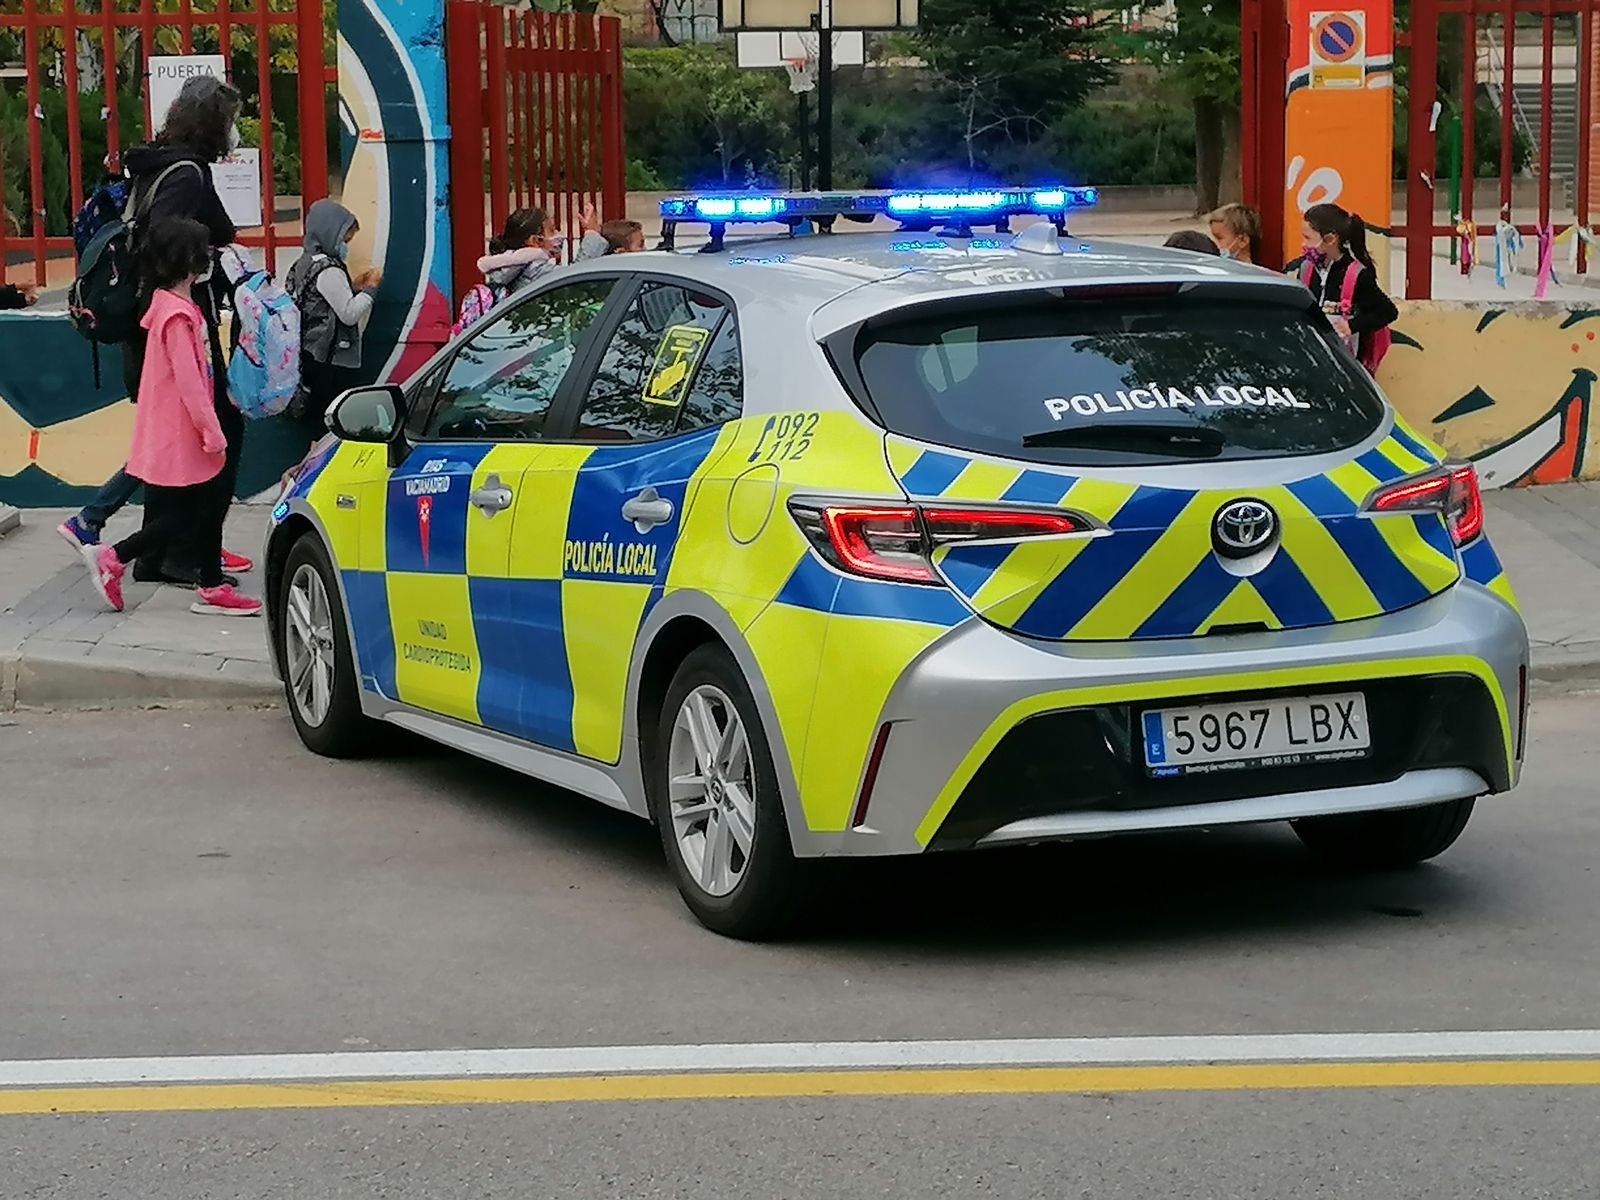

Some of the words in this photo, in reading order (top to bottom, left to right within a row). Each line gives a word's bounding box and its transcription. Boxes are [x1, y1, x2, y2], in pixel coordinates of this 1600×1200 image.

[157, 65, 214, 78] PUERTA
[1044, 382, 1195, 421] POLICÍA
[1194, 385, 1310, 409] LOCAL
[777, 412, 819, 439] 092
[766, 439, 810, 461] 112
[564, 531, 614, 574] POLICÍA
[616, 542, 657, 576] LOCAL
[1173, 708, 1270, 755] 5967
[1285, 700, 1359, 745] LBX
